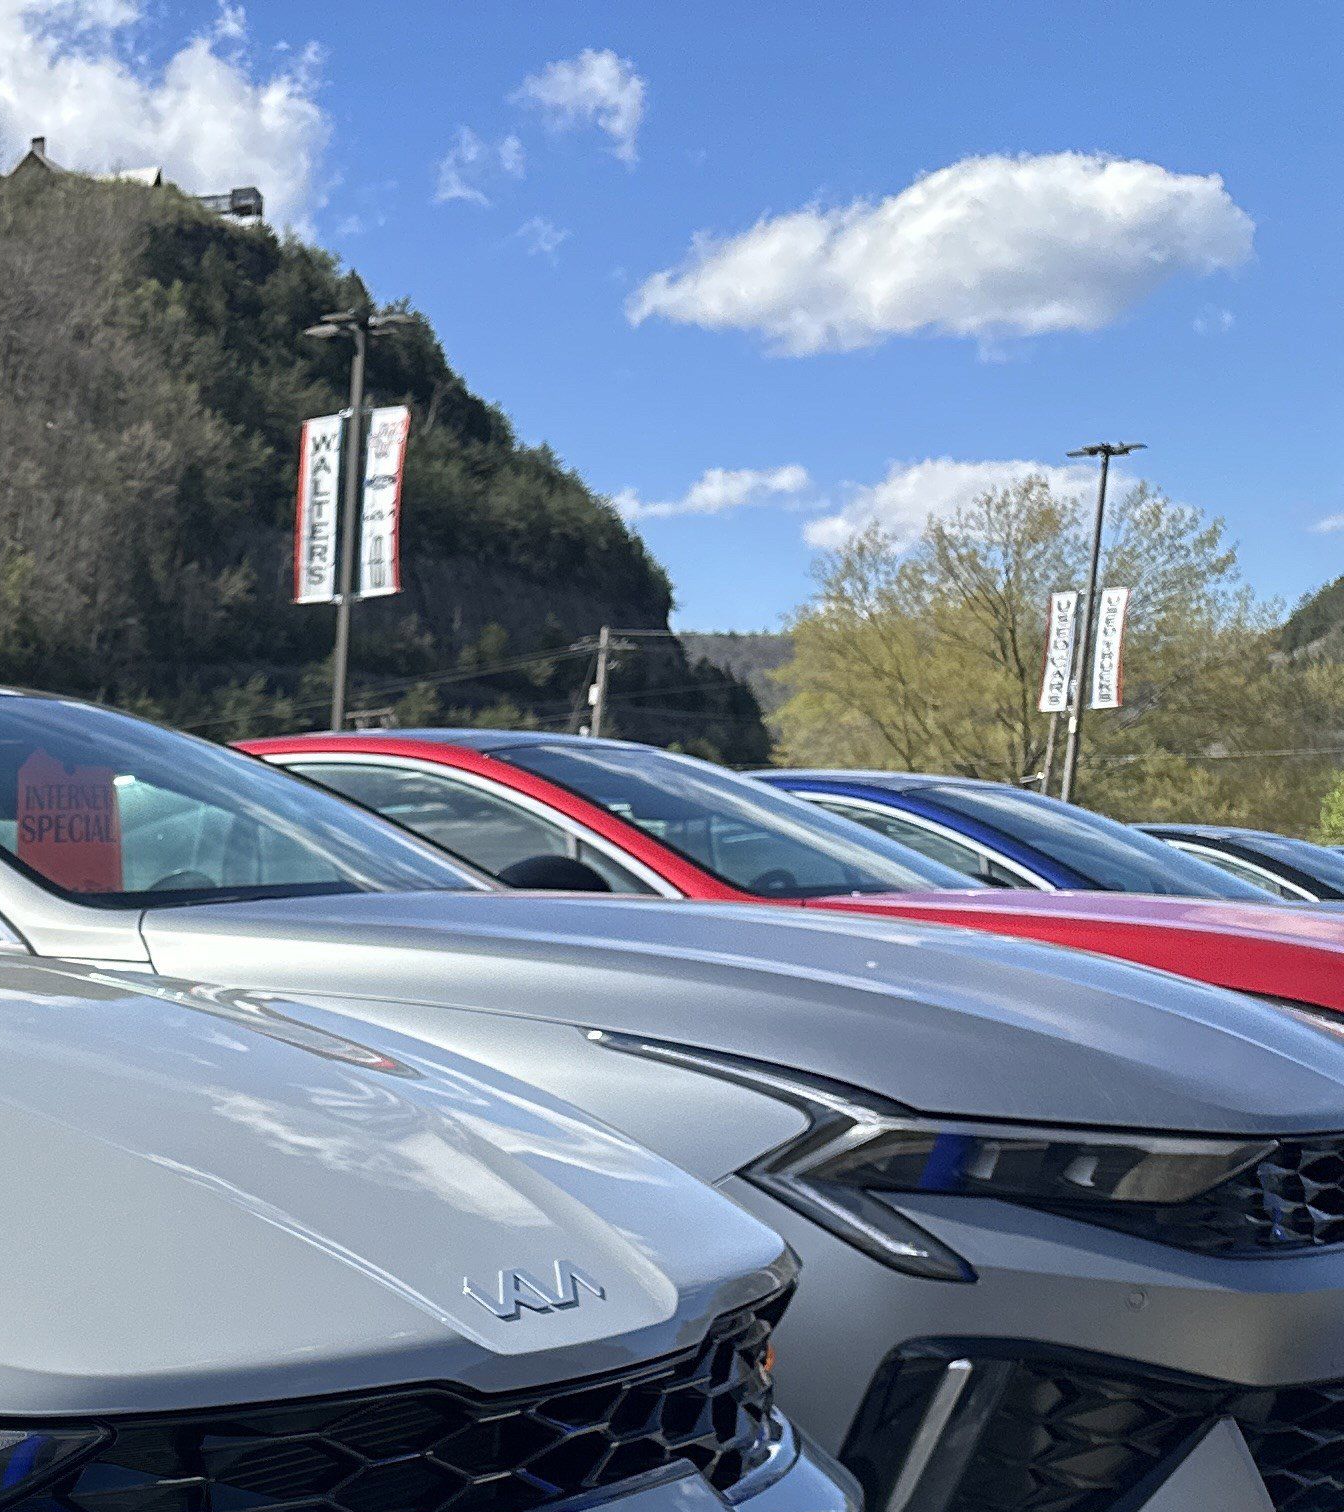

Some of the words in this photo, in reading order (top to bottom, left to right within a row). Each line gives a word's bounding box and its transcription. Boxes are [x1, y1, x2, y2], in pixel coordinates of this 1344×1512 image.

[307, 433, 336, 586] WALTERS
[25, 783, 115, 811] INTERNET
[21, 813, 118, 843] SPECIAL
